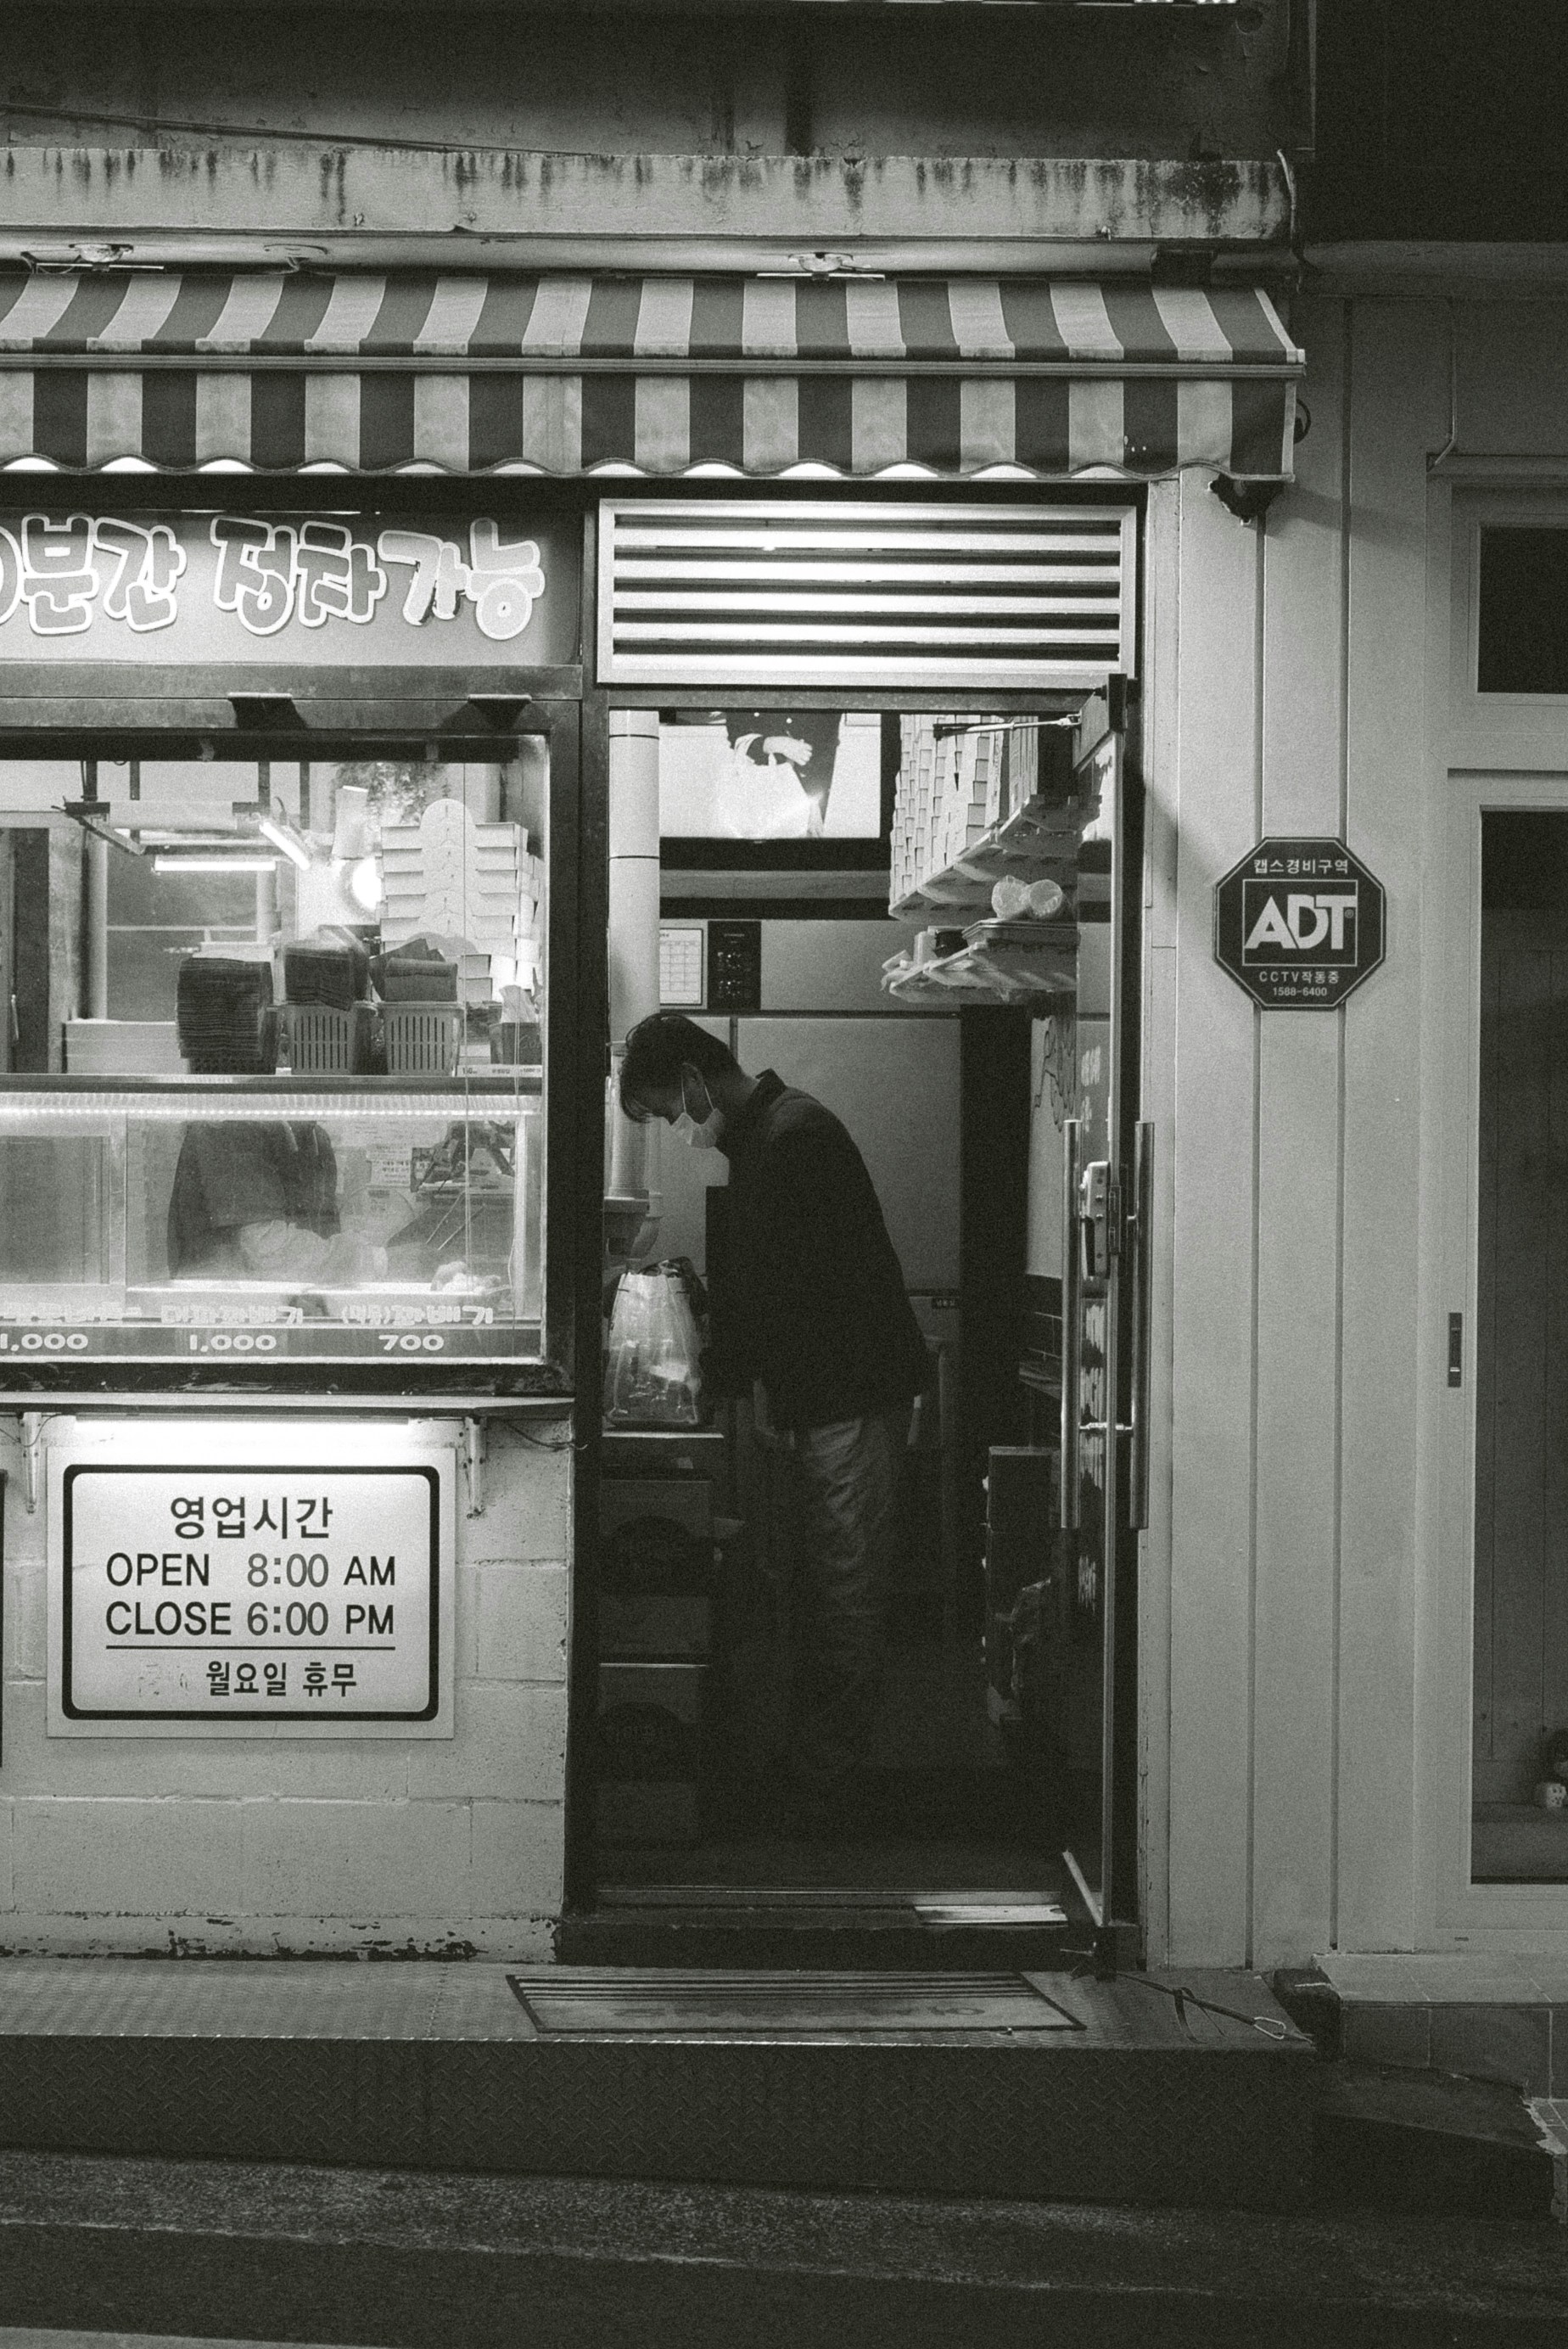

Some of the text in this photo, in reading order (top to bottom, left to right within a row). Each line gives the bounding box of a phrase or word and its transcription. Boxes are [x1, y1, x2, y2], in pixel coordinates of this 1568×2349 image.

[210, 515, 387, 636] 정차
[378, 517, 546, 641] 가능
[1253, 859, 1349, 874] 캡스경비구역
[1244, 894, 1357, 950] ADT
[1273, 987, 1327, 996] 1588-6400
[0, 1332, 89, 1352] 1,000
[189, 1334, 277, 1353] 1,000
[378, 1334, 445, 1351] 700
[170, 1496, 333, 1539] 영업시간
[106, 1552, 396, 1588] OPEN 8:00 AM
[105, 1601, 395, 1635] CLOSE 6:00 PM
[205, 1660, 288, 1697] 월요일
[302, 1662, 357, 1697] 휴무
